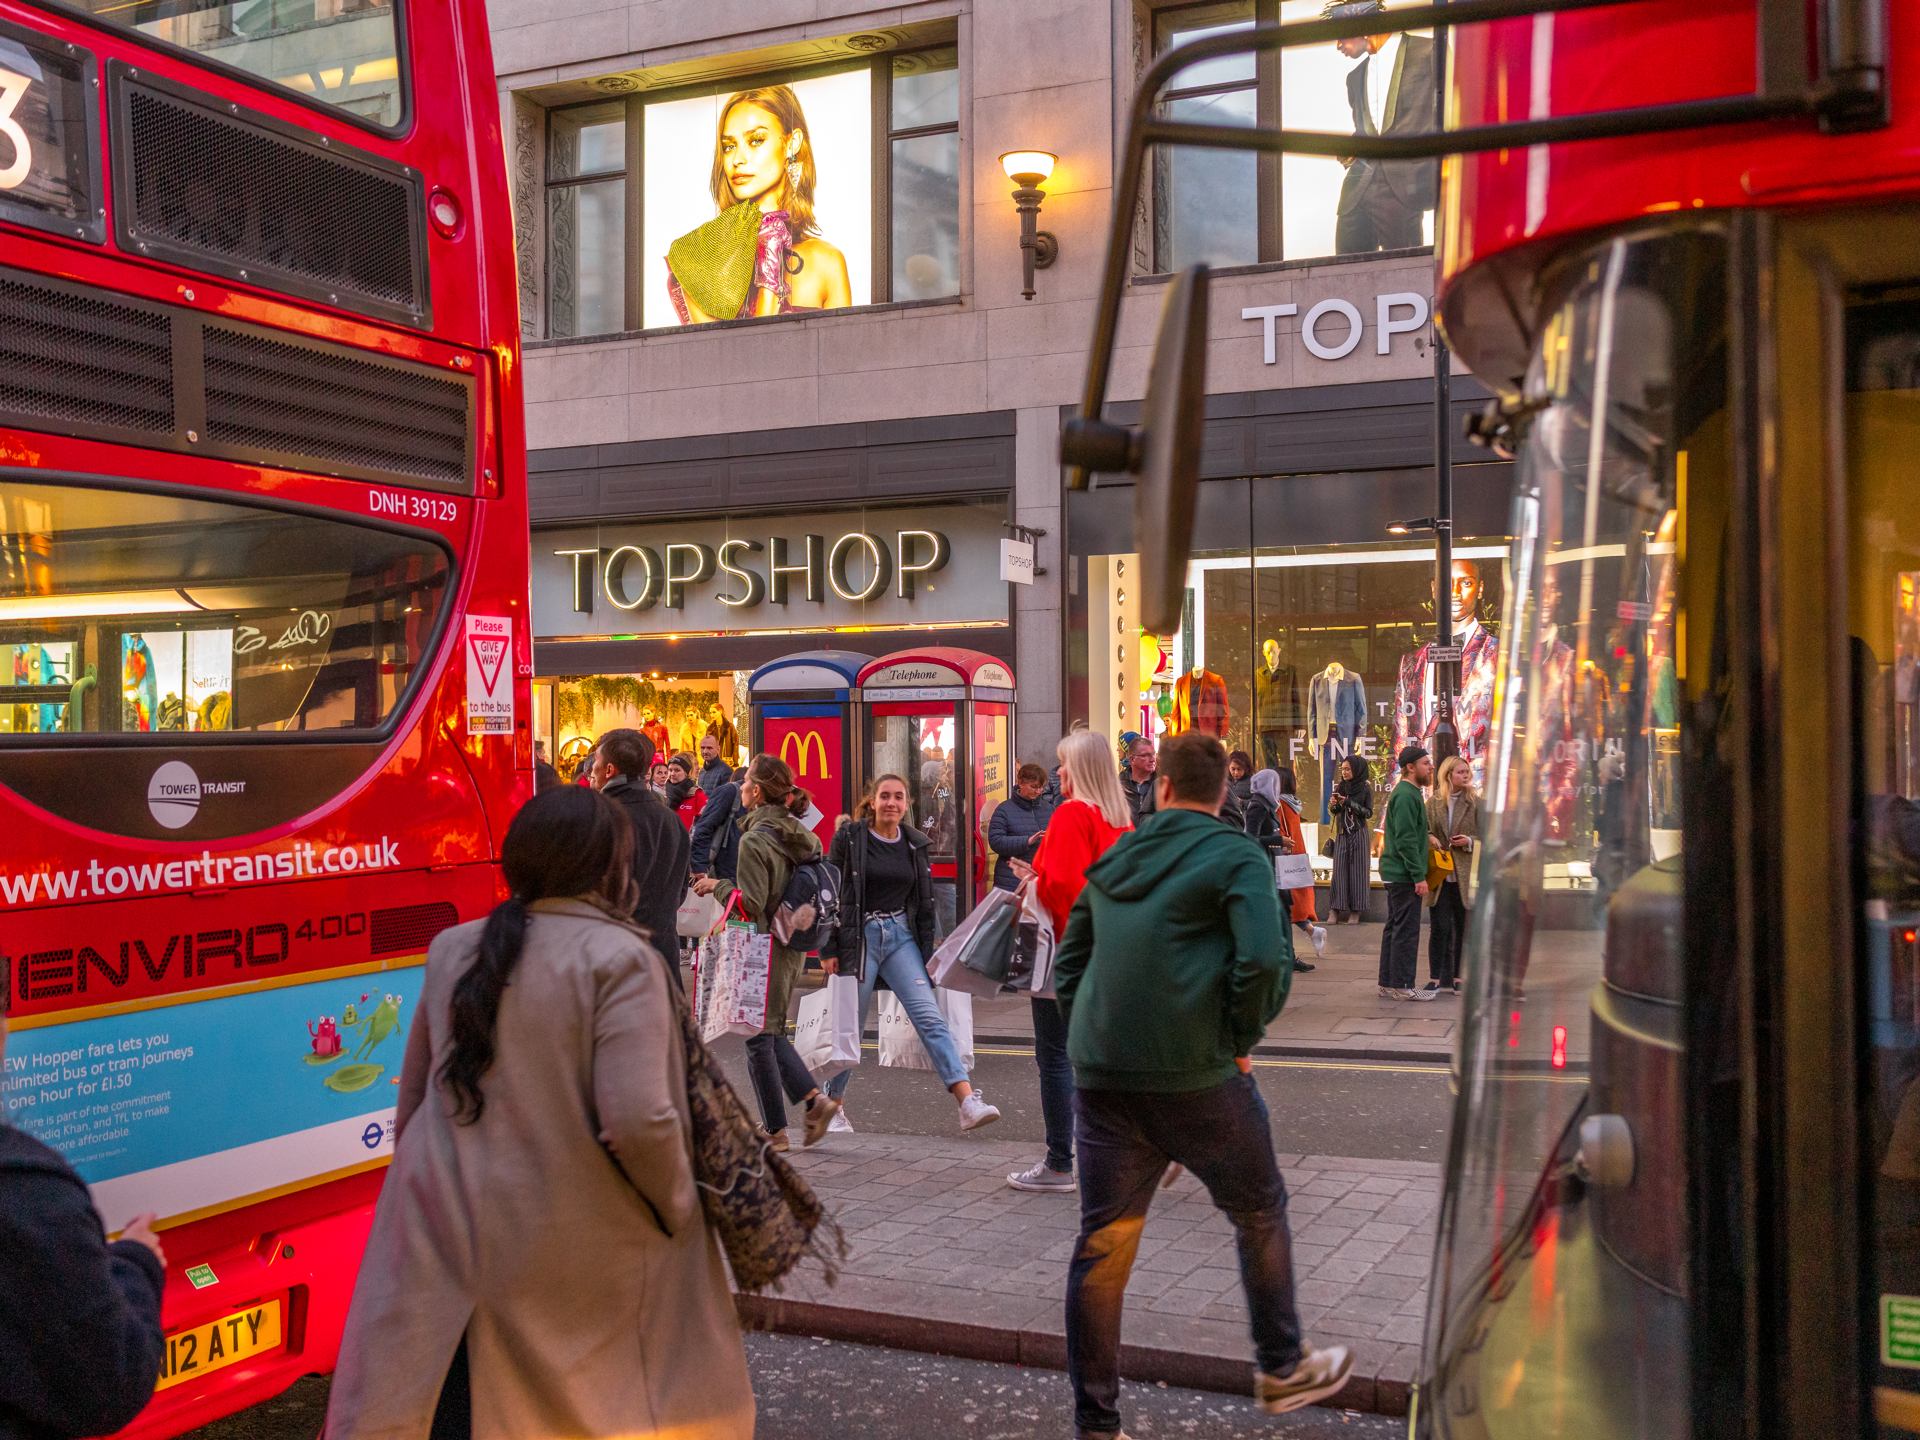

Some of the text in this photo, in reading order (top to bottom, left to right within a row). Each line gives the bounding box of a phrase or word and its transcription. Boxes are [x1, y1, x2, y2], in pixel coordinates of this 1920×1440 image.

[1241, 292, 1429, 365] TOP
[369, 490, 457, 522] DNH 39129
[553, 529, 951, 615] TOPSHOP
[1008, 553, 1032, 569] TOPSHOP
[475, 619, 503, 632] Please
[480, 641, 499, 653] GIVE
[481, 655, 499, 666] WAY
[889, 669, 937, 683] Telephone
[469, 701, 511, 712] to the bus
[1289, 736, 1378, 761] FINE
[159, 782, 246, 795] TOWER TRANSIT
[983, 767, 997, 781] FREE
[18, 911, 367, 1001] ENVIRO 400
[32, 1048, 84, 1068] Hopper
[88, 1043, 114, 1058] fare
[118, 1037, 142, 1052] lets
[145, 1033, 169, 1050] you
[63, 1066, 87, 1081] bus
[91, 1062, 106, 1076] or
[108, 1056, 139, 1072] tram
[141, 1046, 194, 1070] journeys
[8, 1094, 37, 1110] one
[40, 1087, 74, 1104] hour
[77, 1081, 98, 1097] for
[101, 1072, 132, 1092] £1.50
[24, 1090, 172, 1130] fare is part of the commitment
[63, 1121, 91, 1136] Khan,
[93, 1116, 112, 1129] and
[114, 1111, 129, 1124] TfL
[132, 1110, 143, 1121] to
[144, 1104, 170, 1118] make
[208, 1308, 263, 1363] ATY
